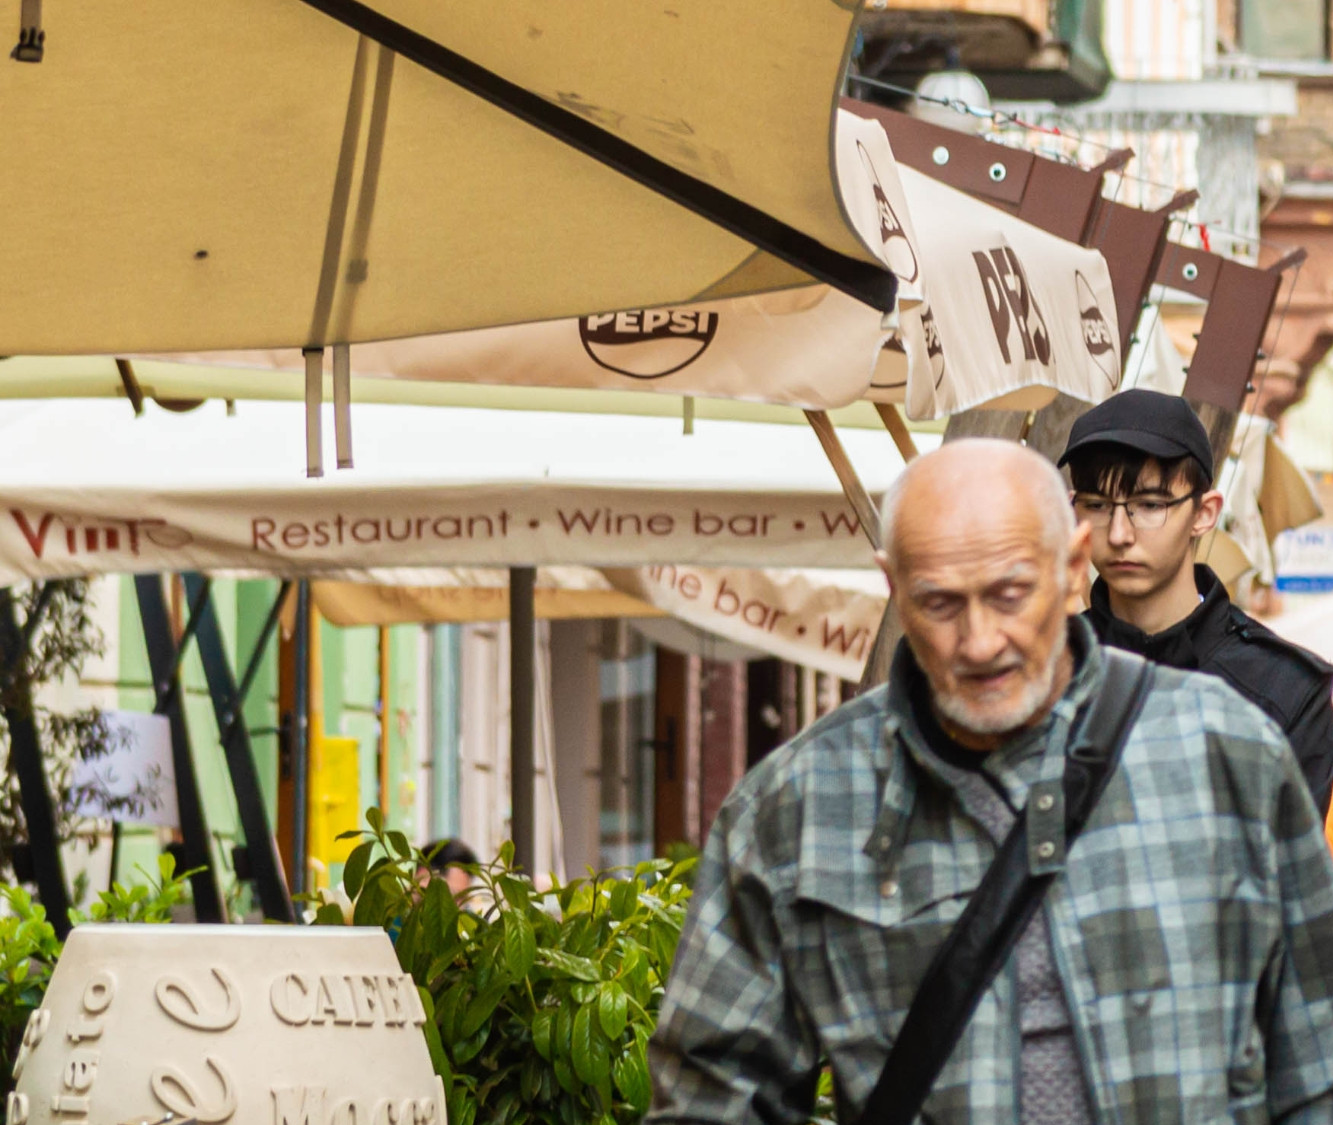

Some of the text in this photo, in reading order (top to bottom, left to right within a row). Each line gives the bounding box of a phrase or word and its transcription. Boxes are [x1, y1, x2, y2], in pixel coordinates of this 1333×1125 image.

[587, 310, 709, 334] PEPSI
[251, 507, 776, 551] Restaurant Wine bar
[714, 577, 788, 634] bar
[822, 616, 871, 661] Wi
